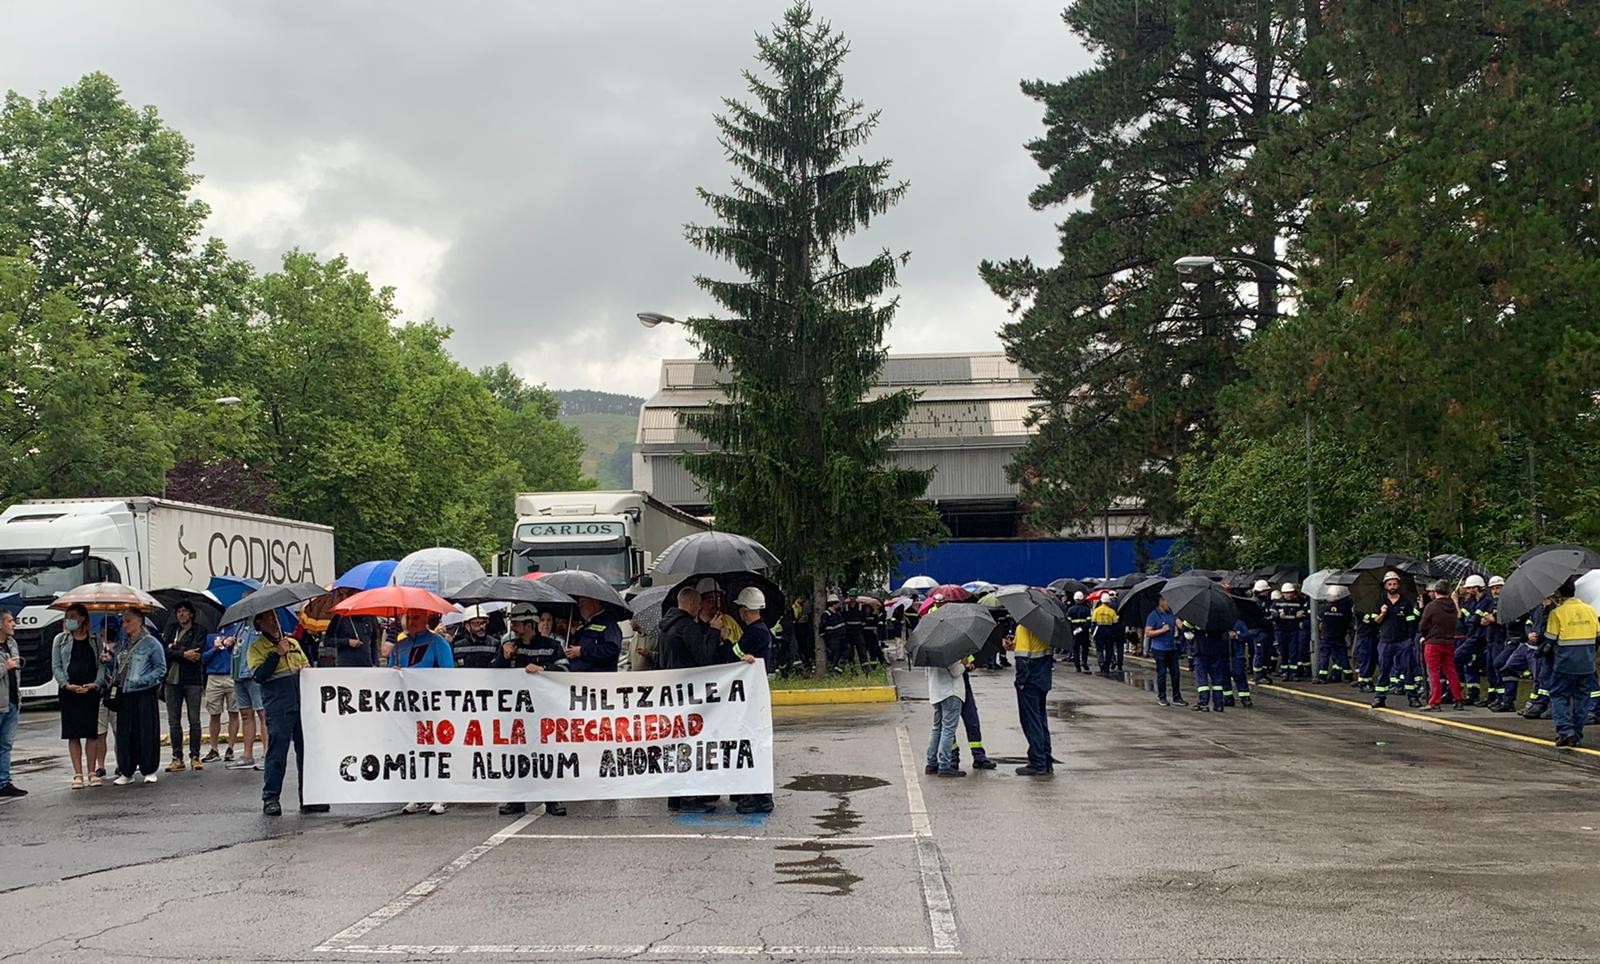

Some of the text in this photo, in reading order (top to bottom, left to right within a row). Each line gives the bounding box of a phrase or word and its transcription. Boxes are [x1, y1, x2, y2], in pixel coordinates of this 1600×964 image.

[530, 524, 612, 536] CARLOS
[208, 532, 316, 585] CODISCA
[15, 616, 38, 625] ECO
[416, 719, 455, 745] NO
[463, 719, 484, 746] A
[492, 718, 527, 745] LA
